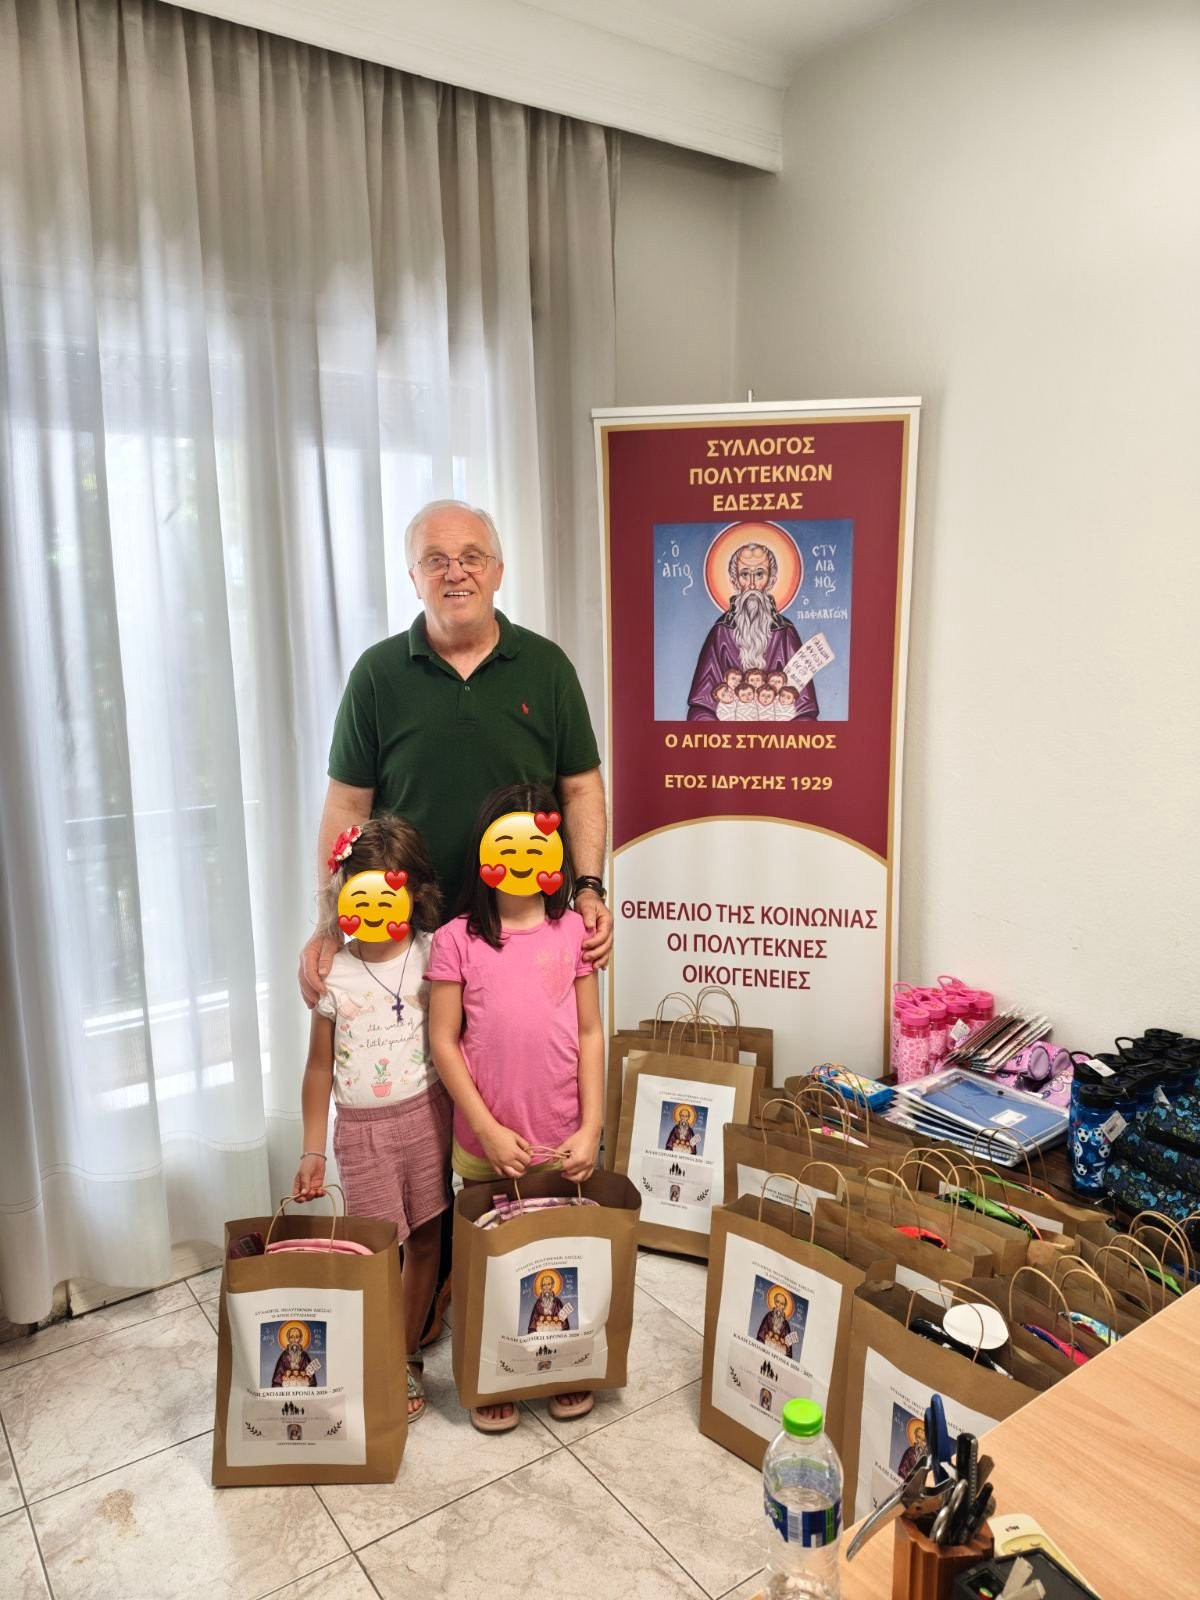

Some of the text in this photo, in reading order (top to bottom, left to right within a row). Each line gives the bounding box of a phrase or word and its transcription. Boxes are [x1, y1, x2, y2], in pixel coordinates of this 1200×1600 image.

[706, 436, 815, 457] ΣΥΛΛΟΓΟΣ
[689, 464, 832, 485] ΠΟΛΥΤΕΚΝΩΝ
[713, 493, 803, 512] ΕΔΕΣΣΑΣ
[665, 734, 837, 750] Ο ΑΓΙΟΣ ΣΤΥΛΙΑΝΟΣ
[665, 775, 833, 791] ΕΤΟΣ ΙΔΡΥΣΗΣ 1929
[621, 900, 878, 929] ΘΕΜΕΛΙΟ ΤΗΣ ΚΟΙΝΩΝΙΑΣ
[667, 933, 828, 959] ΟΙ ΠΟΛΥΤΕΚΝΕΣ
[682, 964, 811, 990] ΟΙΚΟΓΕΝΕΙΕΣ
